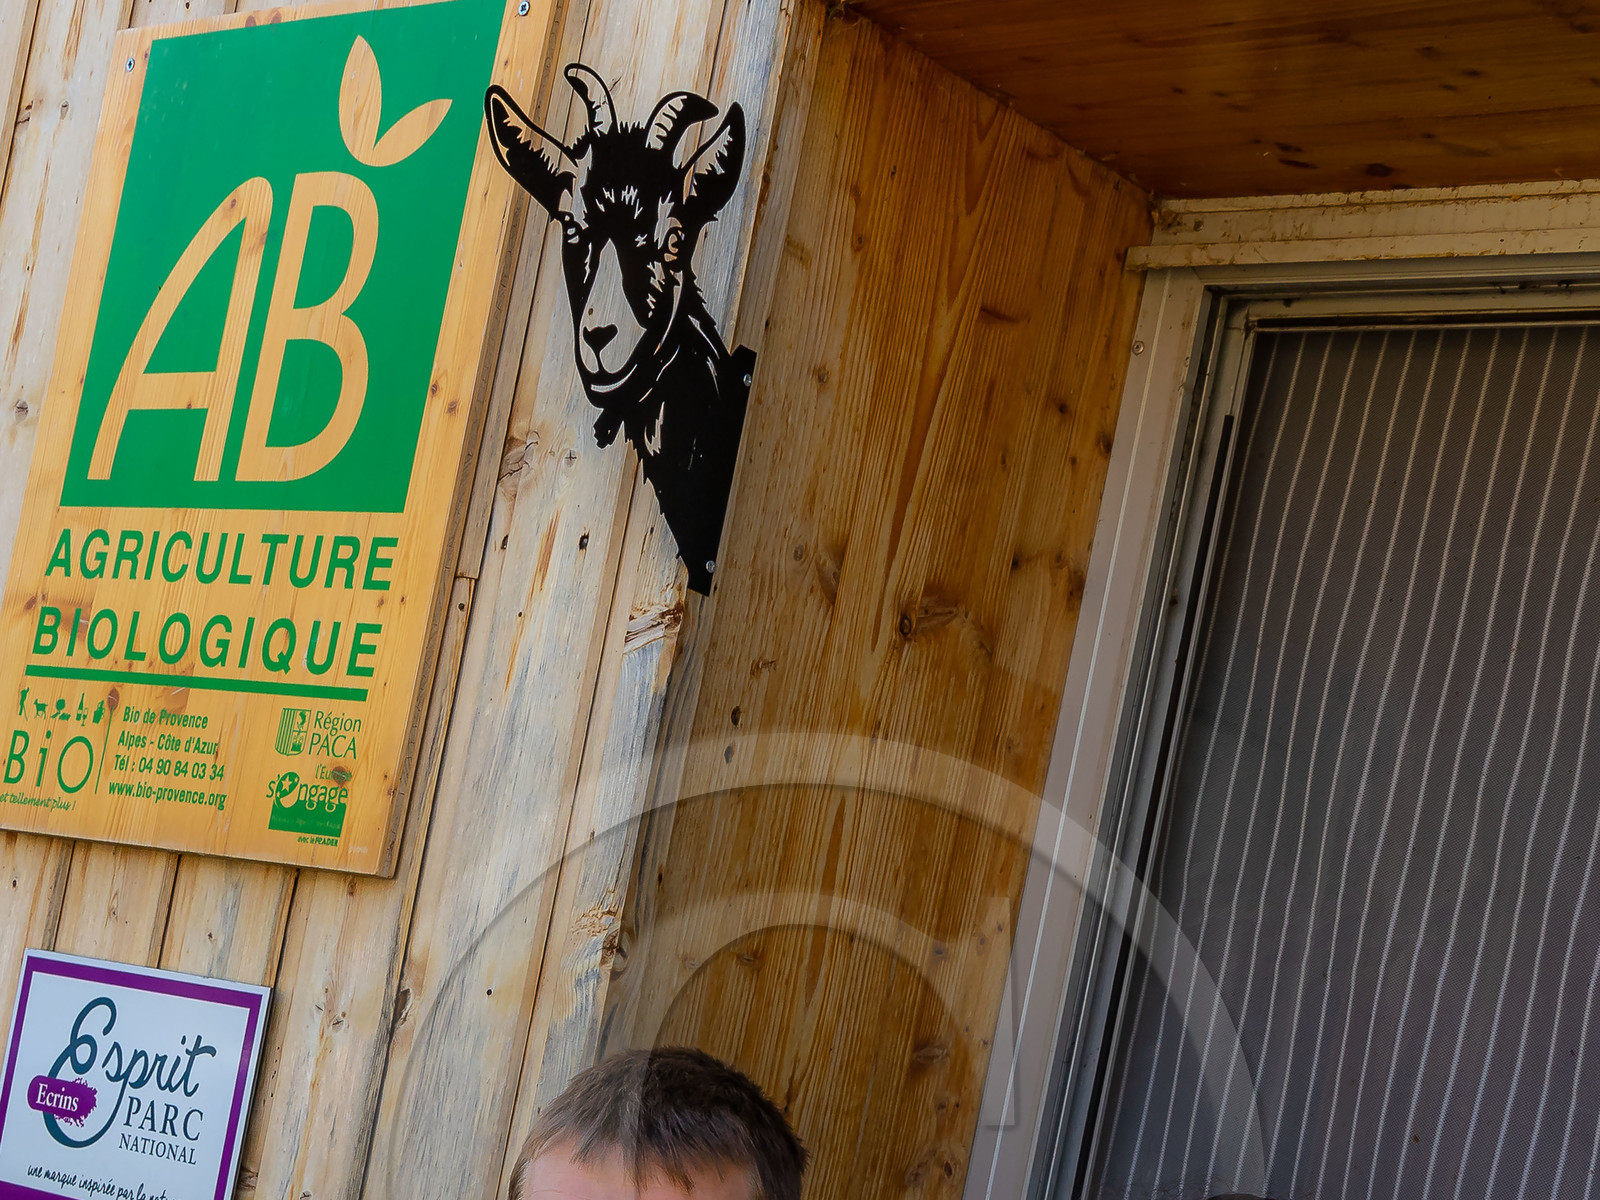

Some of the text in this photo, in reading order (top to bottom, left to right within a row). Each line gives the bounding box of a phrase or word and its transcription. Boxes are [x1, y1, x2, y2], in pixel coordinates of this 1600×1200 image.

[86, 171, 380, 483] AB
[44, 528, 400, 591] AGRICULTURE
[32, 605, 383, 678] BIOLOGIQUE
[123, 706, 208, 729] Bio de Provence
[313, 710, 362, 736] Région
[117, 730, 146, 750] Alpes
[157, 733, 180, 752] Côte
[184, 736, 219, 755] d'Azur
[308, 733, 357, 760] PACA
[114, 754, 128, 771] Tél
[138, 757, 153, 774] 04
[156, 758, 171, 776] 90
[173, 760, 188, 777] 84
[191, 762, 206, 780] 03
[209, 764, 225, 782] 34
[108, 780, 227, 811] www.bio-provence.org
[35, 1083, 80, 1113] Ecrins
[123, 1095, 204, 1141] PARC
[118, 1132, 197, 1166] NATIONAL
[27, 1164, 43, 1178] une
[43, 1169, 77, 1189] marque
[79, 1174, 116, 1197] inspirée
